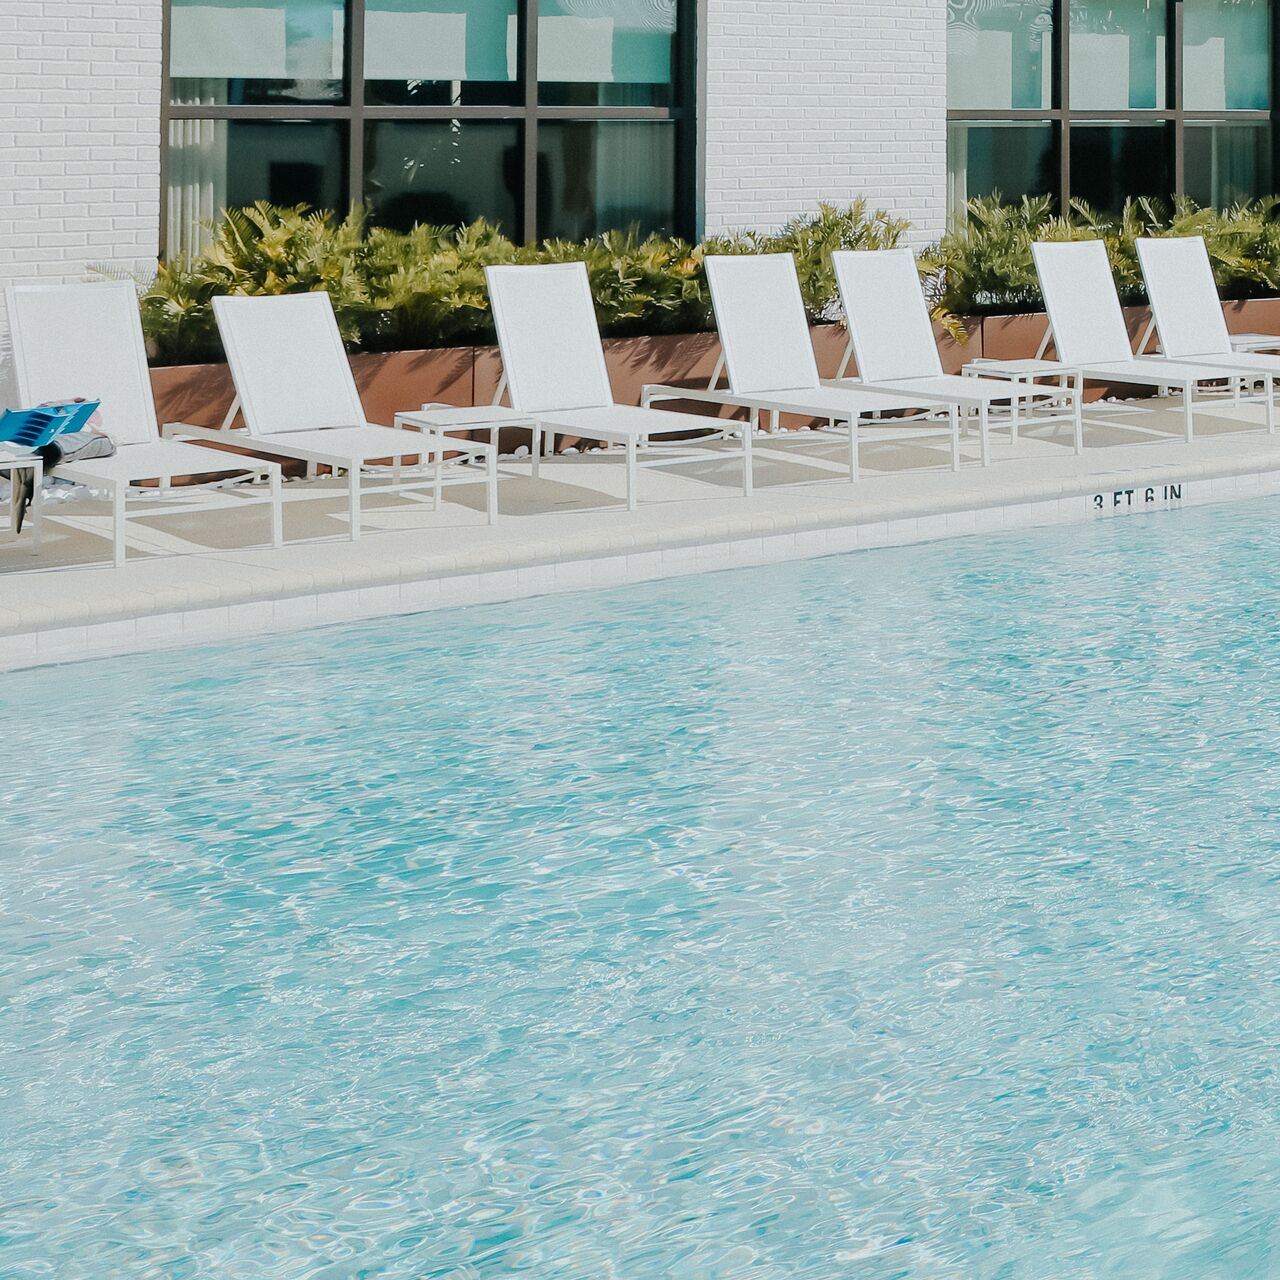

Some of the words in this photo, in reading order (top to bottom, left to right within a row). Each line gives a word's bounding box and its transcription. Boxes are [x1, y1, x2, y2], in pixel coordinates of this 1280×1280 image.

[1093, 494, 1104, 510] 3
[1113, 489, 1134, 507] FT
[1163, 483, 1182, 501] IN
